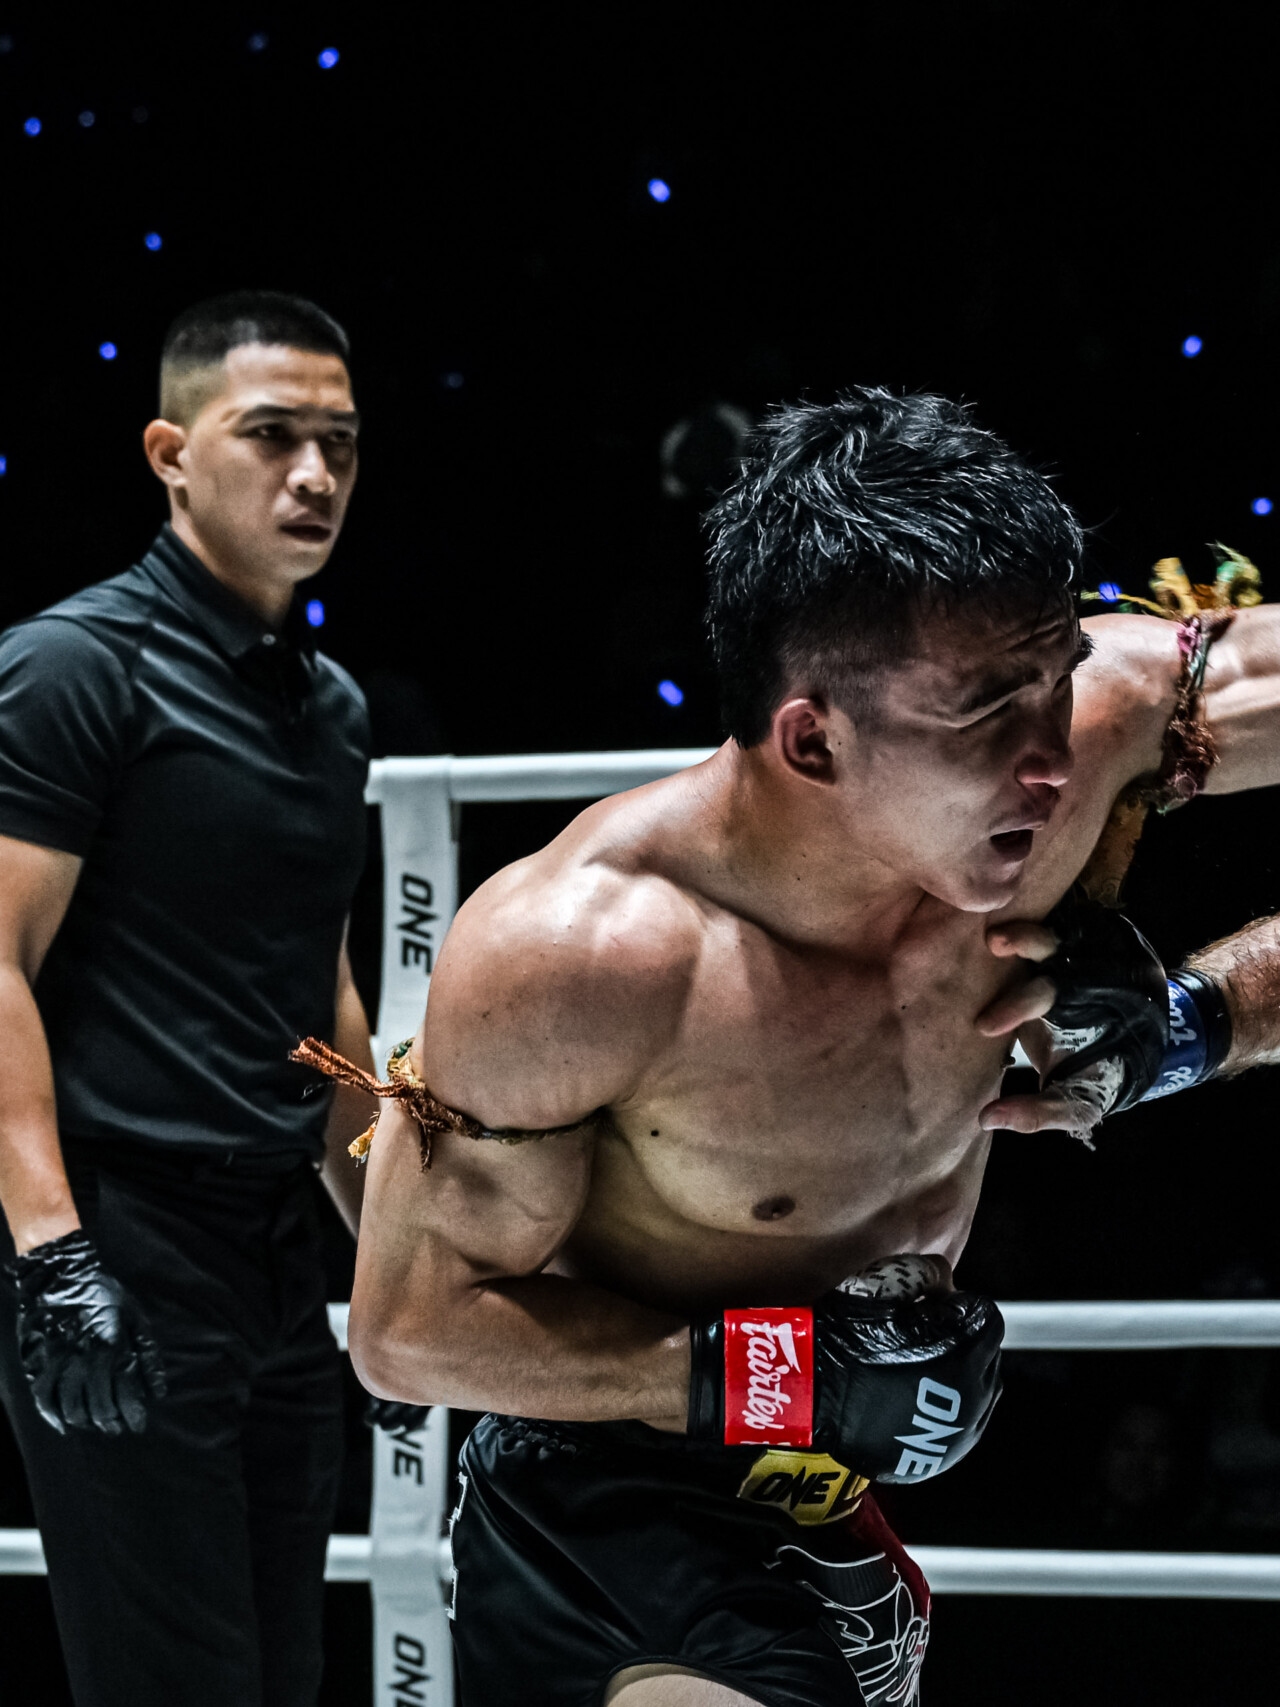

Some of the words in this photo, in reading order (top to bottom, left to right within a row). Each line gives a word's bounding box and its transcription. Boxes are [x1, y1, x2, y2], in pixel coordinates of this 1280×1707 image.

[397, 873, 440, 976] ONE
[740, 1321, 802, 1431] Fairtex
[389, 1426, 424, 1486] NE
[893, 1376, 965, 1479] ONE
[751, 1466, 842, 1511] ONE
[387, 1633, 434, 1707] ON
